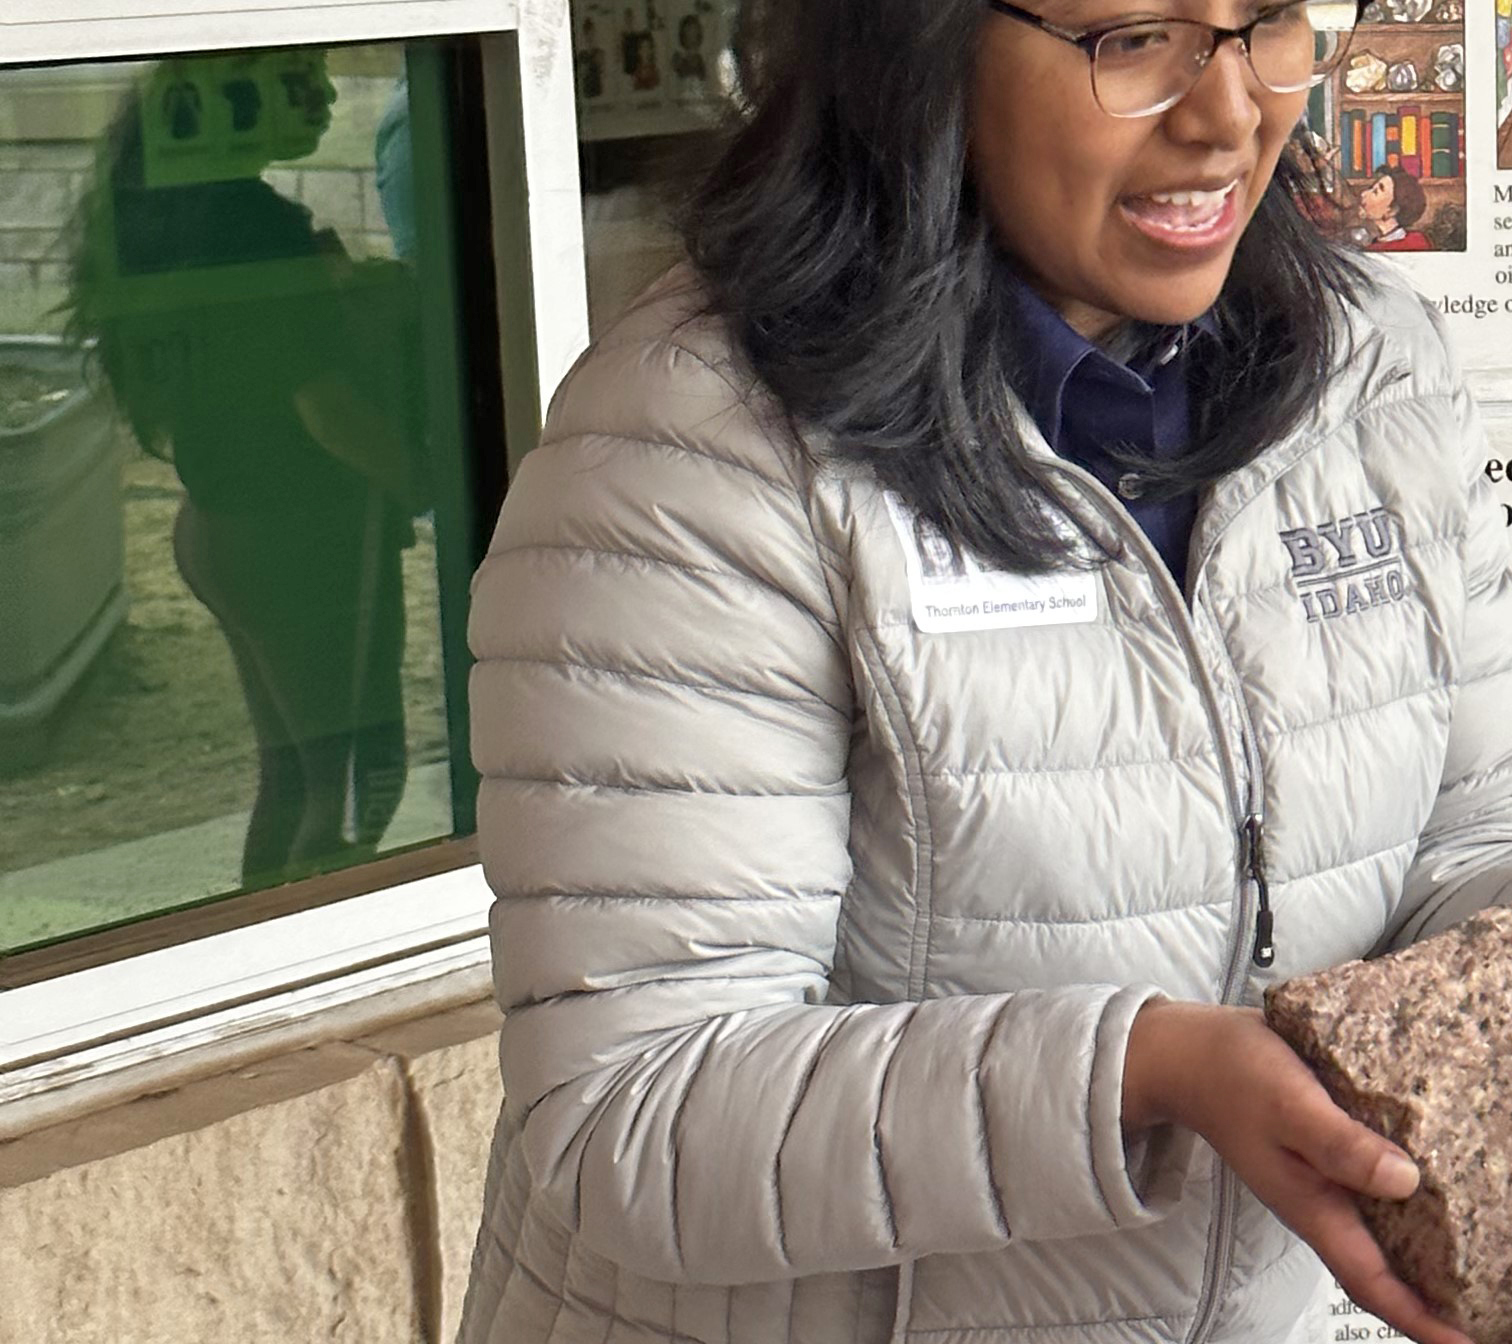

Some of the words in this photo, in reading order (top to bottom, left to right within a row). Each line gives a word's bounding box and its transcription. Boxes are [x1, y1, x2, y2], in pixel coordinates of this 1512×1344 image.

[1279, 507, 1392, 577] BYU
[925, 605, 979, 617] Thornton
[983, 600, 1045, 613] Elementary
[1049, 595, 1086, 609] School
[1300, 570, 1404, 623] IDAHO
[1335, 1324, 1370, 1341] also
